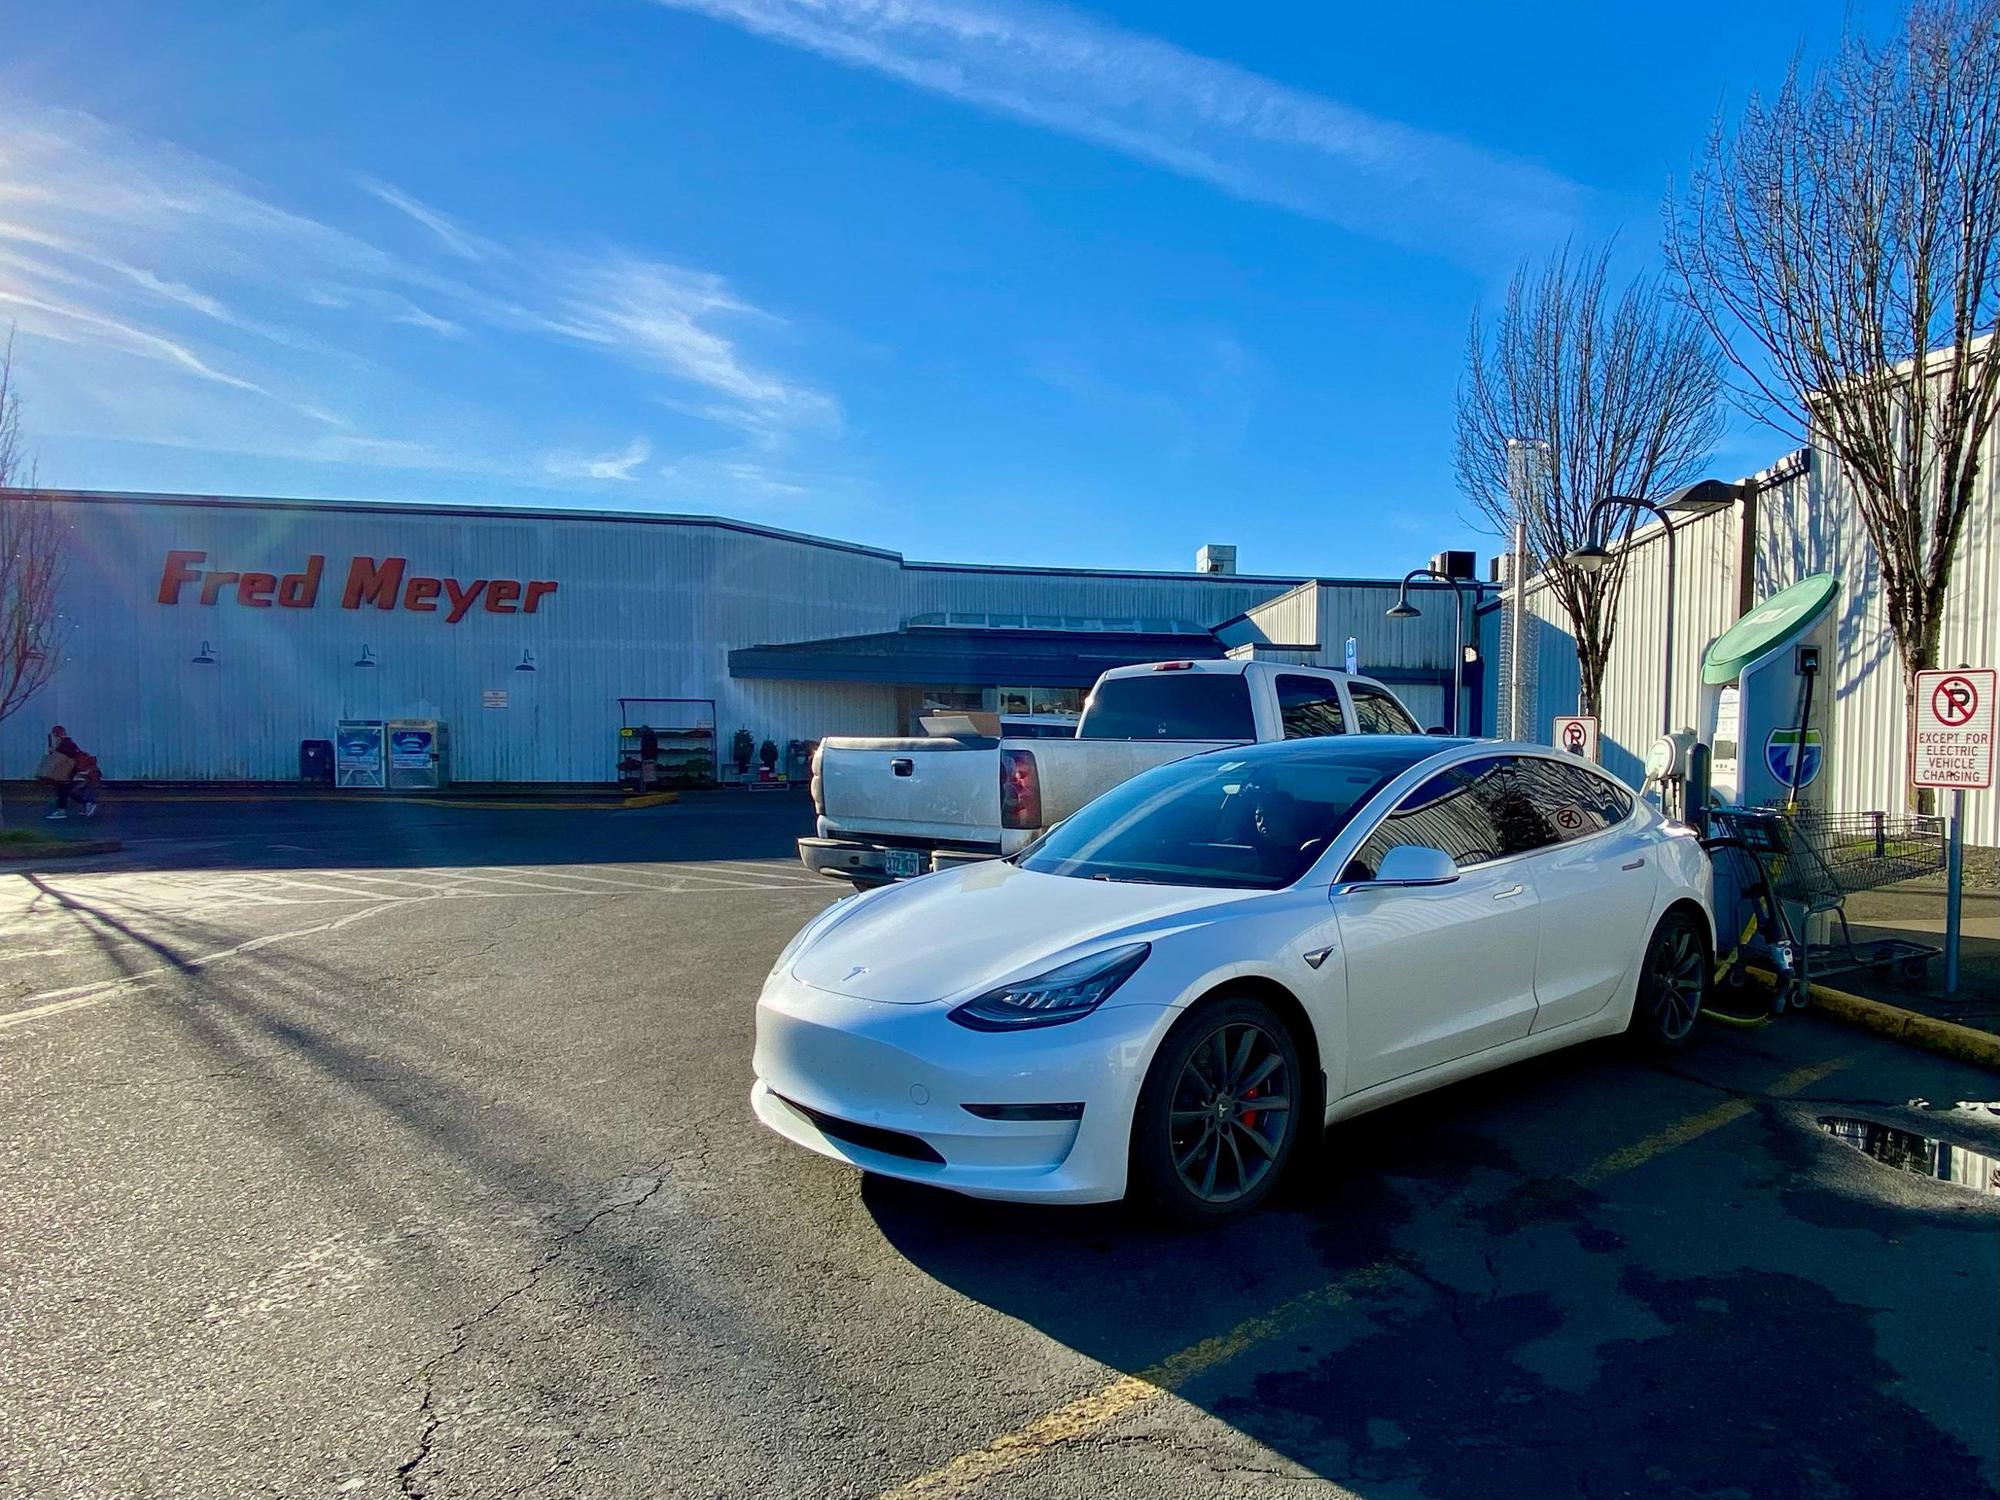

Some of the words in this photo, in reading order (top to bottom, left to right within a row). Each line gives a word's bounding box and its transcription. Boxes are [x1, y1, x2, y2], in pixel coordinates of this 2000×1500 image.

[157, 550, 326, 608] Fred
[342, 556, 559, 623] Meyer
[1919, 733, 1959, 744] EXCEPT
[1965, 733, 1989, 744] FOR
[1926, 745, 1978, 757] ELECTRIC
[1929, 757, 1976, 770] VEHICLE
[1923, 769, 1980, 782] CHARGING
[1763, 798, 1789, 808] WES
